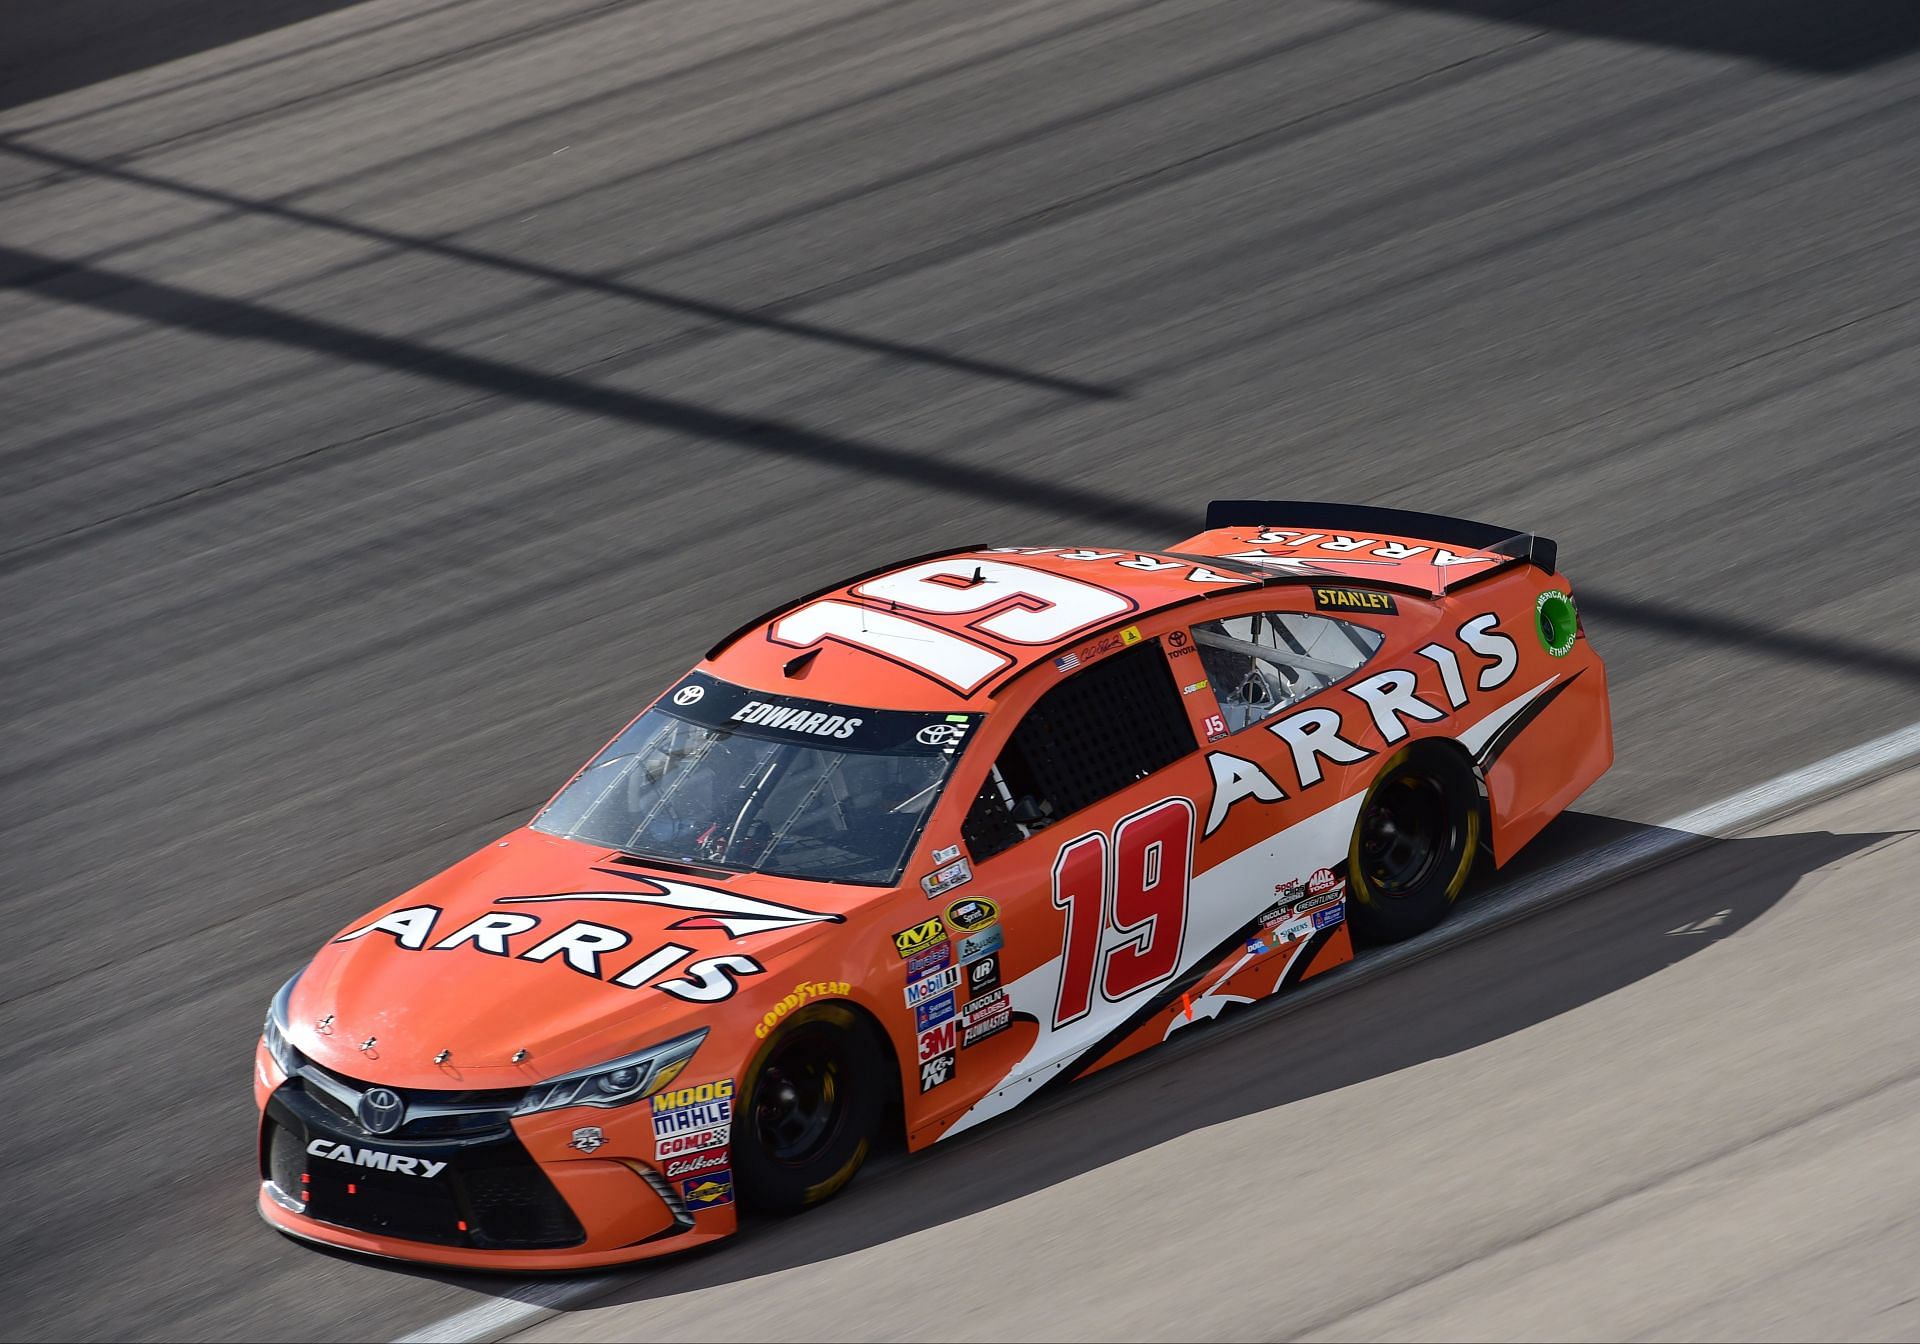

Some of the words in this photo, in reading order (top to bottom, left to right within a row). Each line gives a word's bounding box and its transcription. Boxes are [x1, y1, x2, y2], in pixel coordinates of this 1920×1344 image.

[1246, 531, 1502, 567] ARRIS
[1317, 589, 1389, 609] STANLEY
[1536, 590, 1568, 614] AMERICAN
[767, 557, 1139, 700] 19
[1168, 645, 1197, 660] TOYOTA
[1549, 632, 1576, 657] ETHANOL
[730, 700, 864, 740] EDWARDS
[1203, 612, 1519, 839] ARRIS
[1204, 714, 1225, 736] J5
[1274, 877, 1300, 894] Sport
[1309, 880, 1335, 893] TOOLS
[1051, 795, 1197, 1031] 19
[1297, 890, 1340, 911] FREIGHTLINER
[962, 909, 983, 923] Sprint
[1259, 905, 1288, 925] LINCOLN
[330, 904, 766, 1003] ARRIS
[907, 973, 943, 1002] Mobil
[945, 967, 957, 985] 1
[755, 981, 852, 1039] GOODYEAR
[964, 989, 1003, 1015] LINCOLN
[972, 1000, 1006, 1021] WELDERS
[920, 1020, 954, 1060] 3M
[653, 1079, 733, 1113] MOOG
[654, 1101, 731, 1135] MAHLE
[576, 1136, 601, 1149] 25
[660, 1131, 712, 1156] COMP
[305, 1138, 448, 1179] CAMRY
[666, 1151, 729, 1177] Edelbrock
